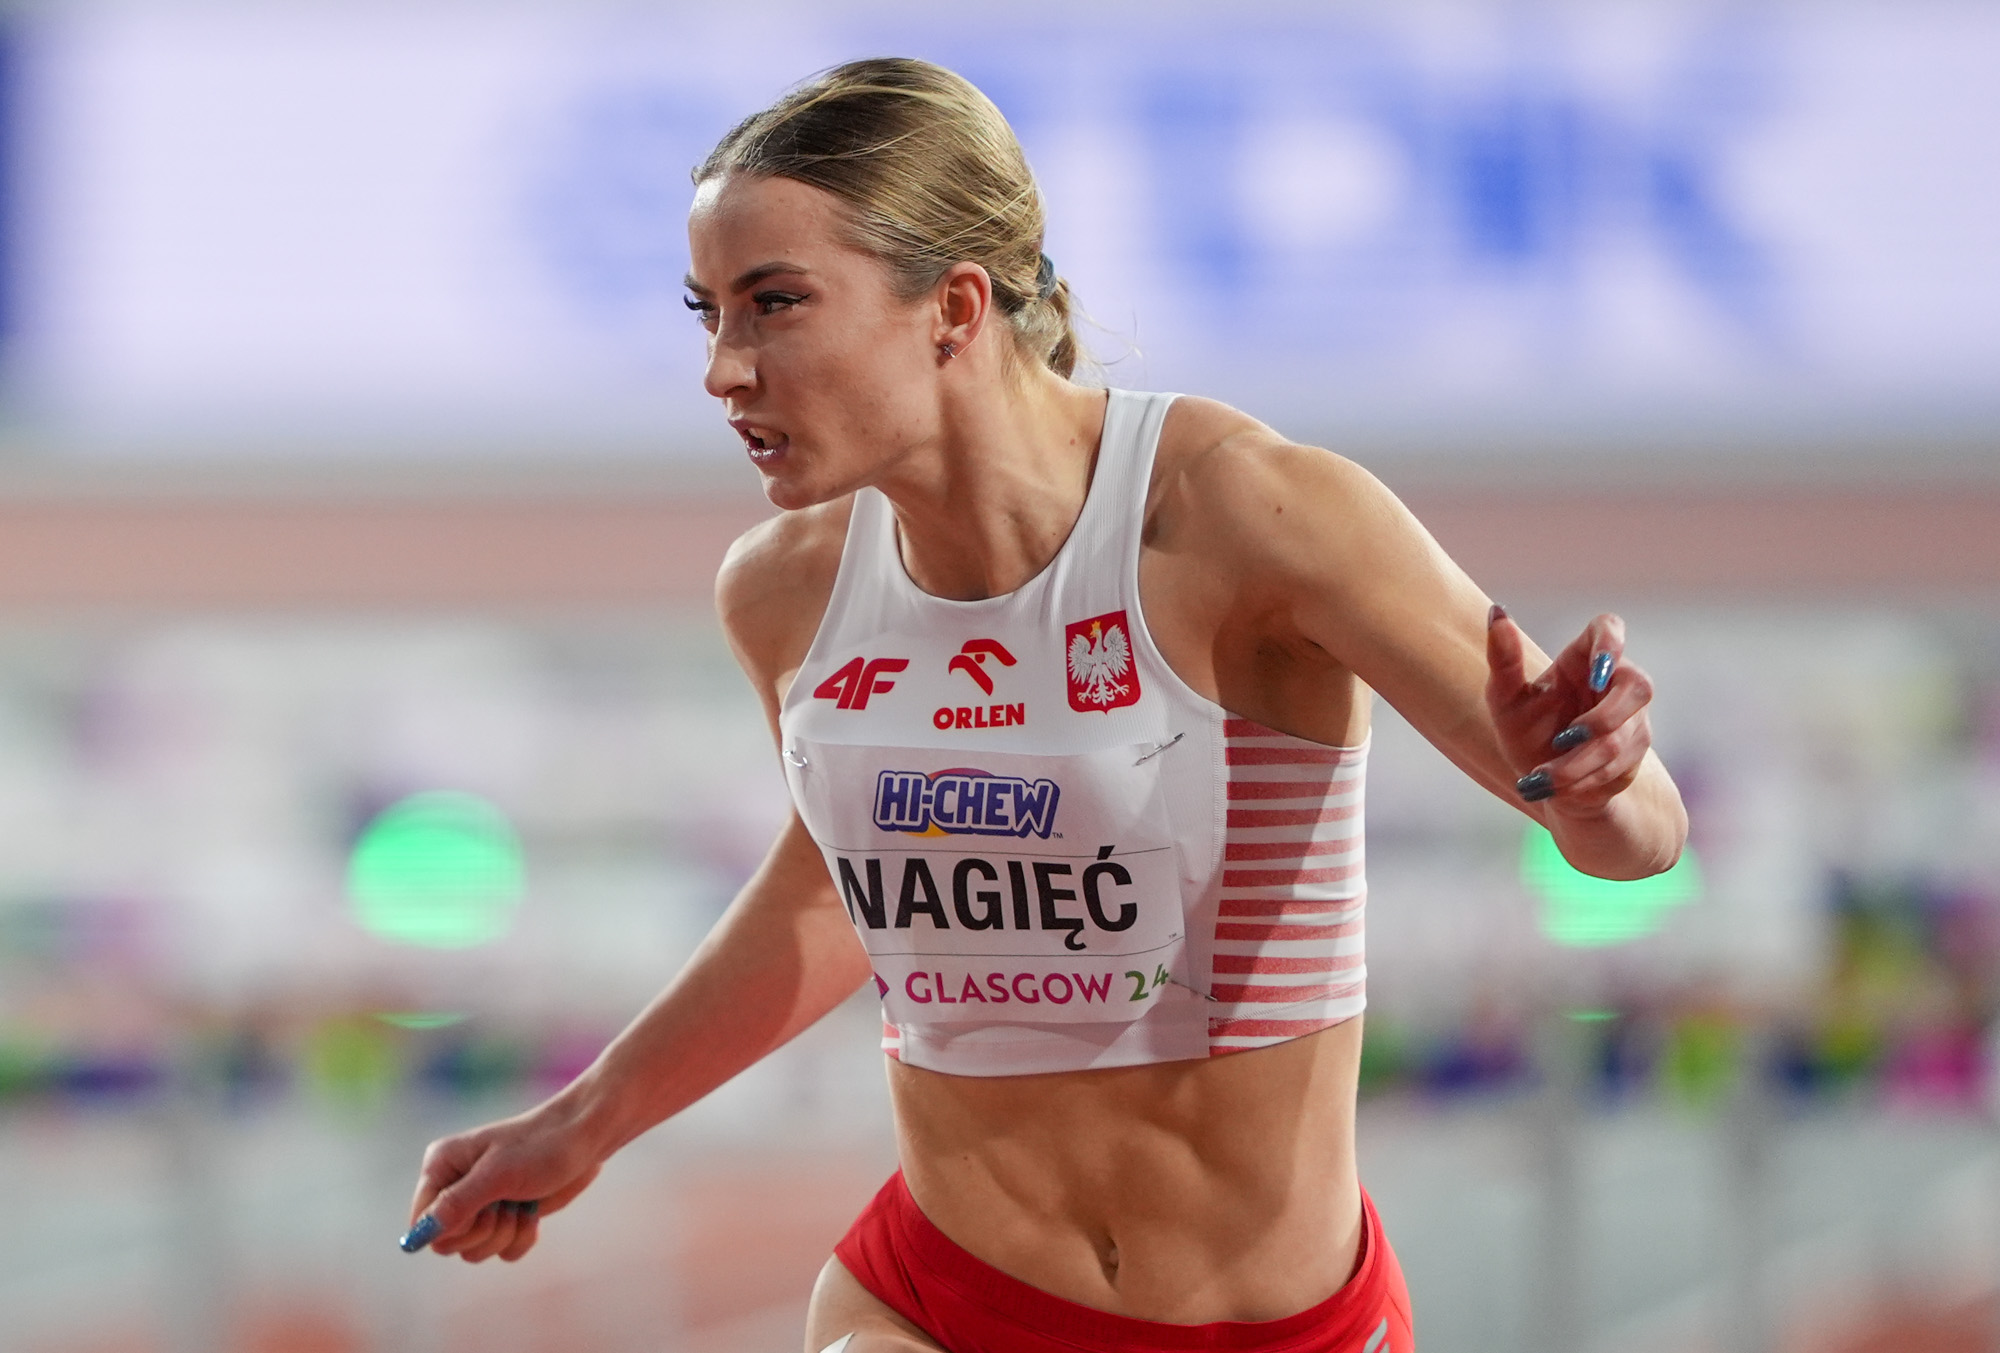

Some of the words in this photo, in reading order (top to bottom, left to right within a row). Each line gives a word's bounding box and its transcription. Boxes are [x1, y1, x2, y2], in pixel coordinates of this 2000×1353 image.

[813, 656, 909, 710] 4F
[933, 703, 1025, 730] ORLEN
[874, 770, 1060, 838] HI-CHEW
[837, 845, 1138, 950] NAGIĘĆ
[905, 972, 1113, 1004] GLASGOW
[1125, 963, 1169, 1002] 24
